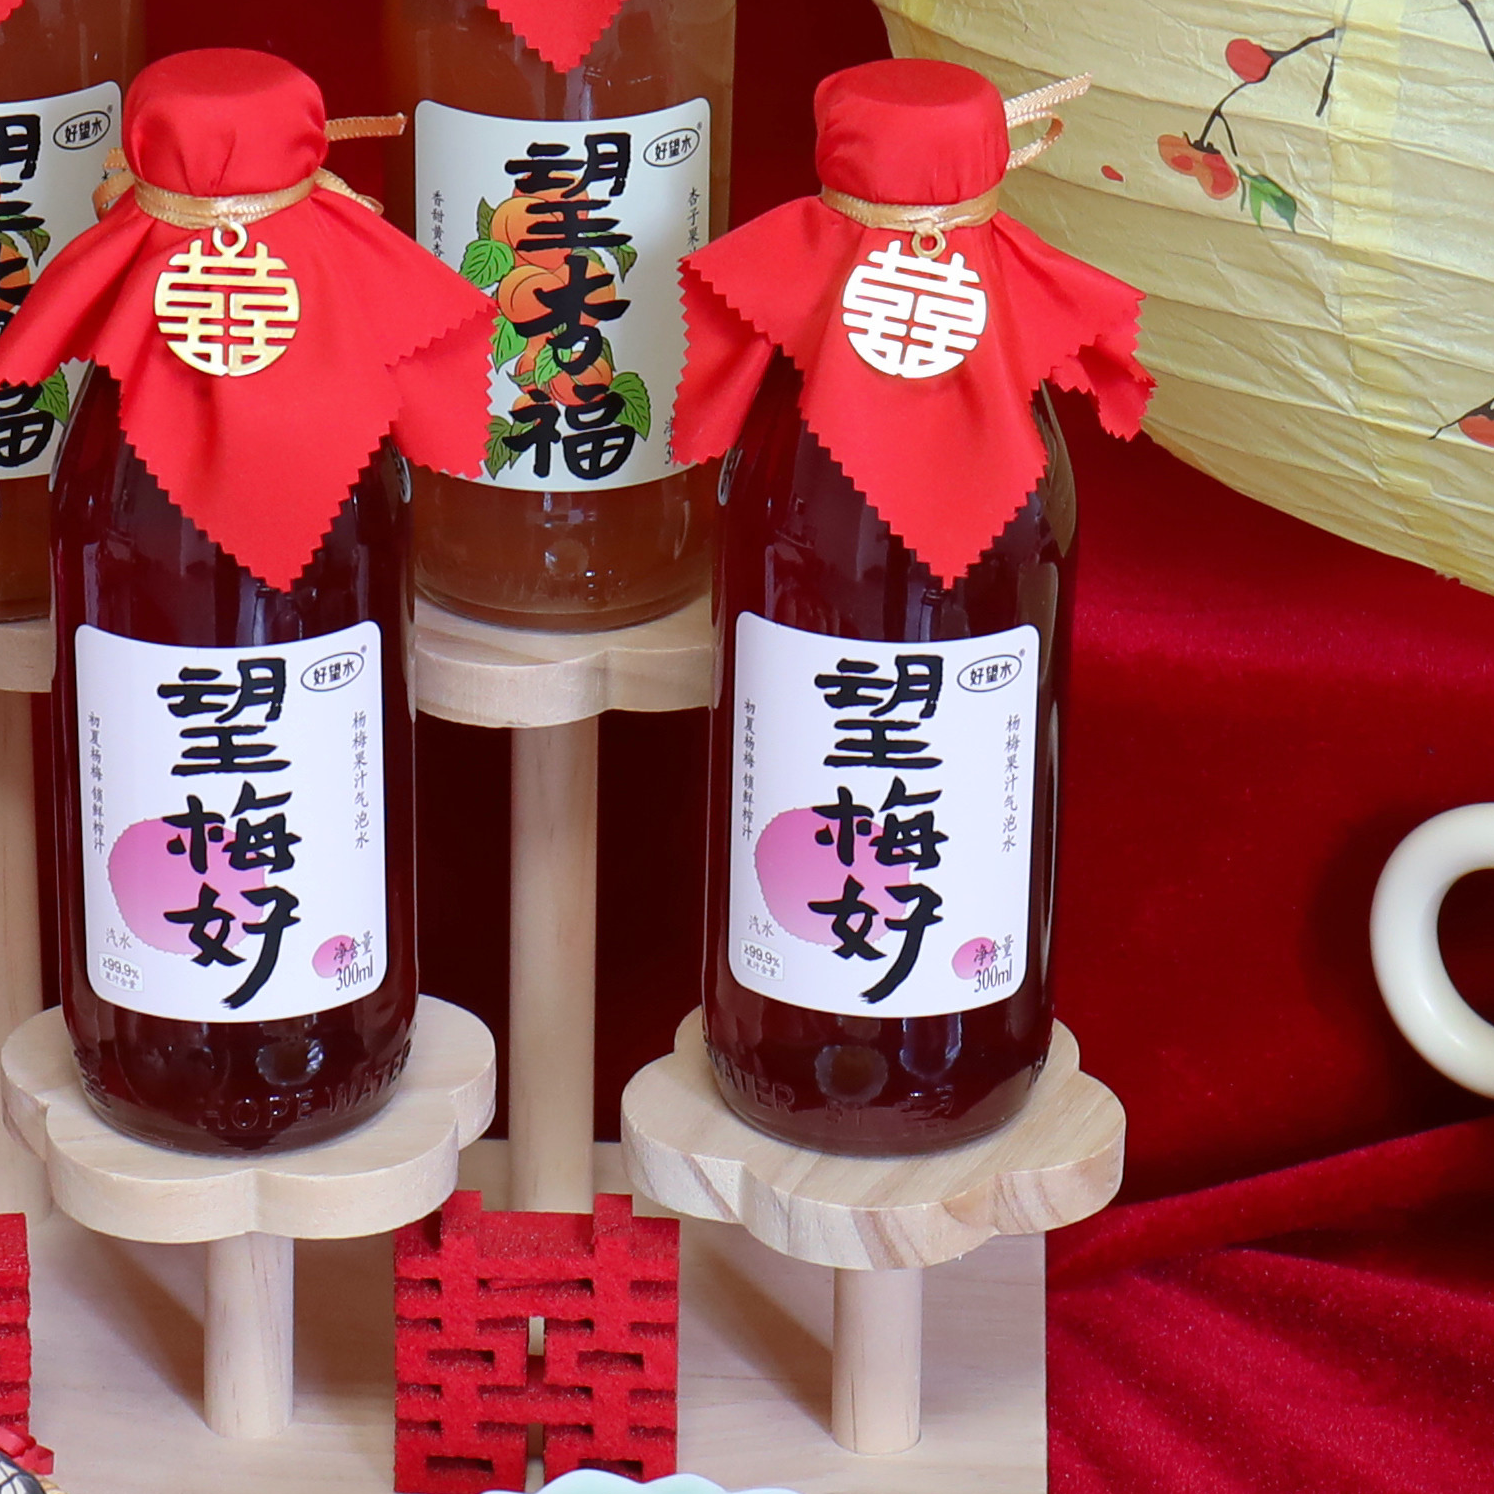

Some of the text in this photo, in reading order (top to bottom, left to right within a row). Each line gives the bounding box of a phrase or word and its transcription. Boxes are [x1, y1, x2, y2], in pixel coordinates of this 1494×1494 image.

[65, 121, 102, 145] 好望水
[655, 137, 692, 161] 好望水
[502, 132, 635, 478] 望杏福
[313, 659, 355, 686] 好望水
[969, 660, 1012, 687] 好望水
[352, 711, 370, 849] 杨梅果汁气泡水
[1001, 713, 1021, 853] 杨梅果汁气泡水
[157, 658, 302, 1009] 望梅好
[808, 655, 949, 1004] 望梅好
[106, 927, 132, 949] 汽水
[748, 915, 775, 938] 汽水
[333, 930, 373, 965] 净含量
[974, 935, 1014, 967] 净含量
[335, 957, 374, 991] 300ml
[973, 959, 1013, 993] 300ml
